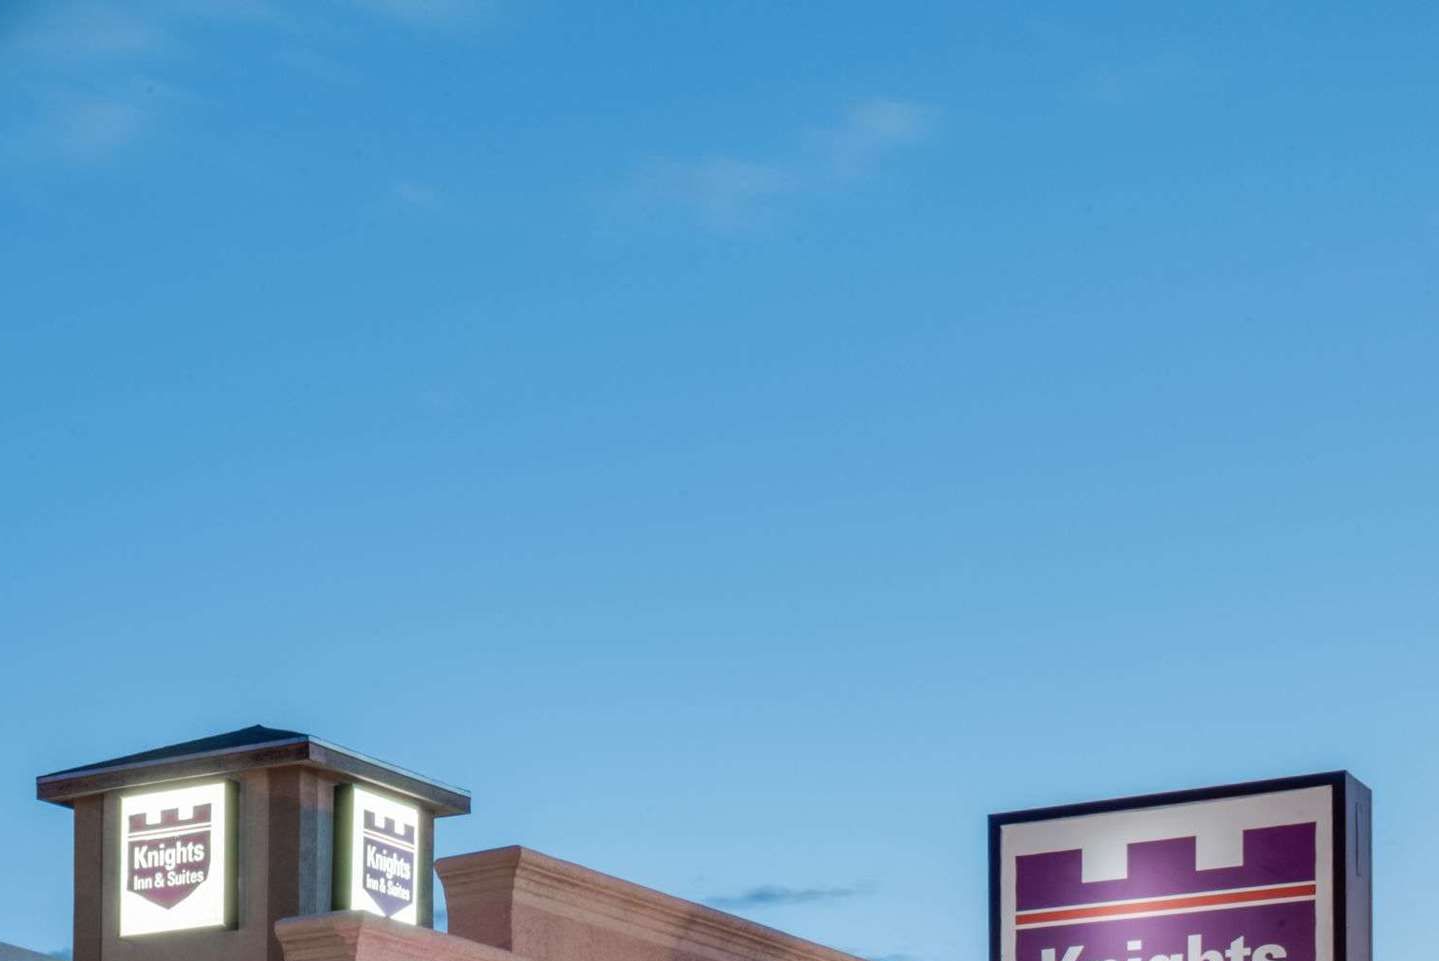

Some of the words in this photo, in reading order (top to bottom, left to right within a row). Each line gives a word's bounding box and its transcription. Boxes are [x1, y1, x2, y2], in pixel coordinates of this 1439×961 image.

[134, 841, 205, 871] Knights
[366, 844, 411, 880] Knights
[133, 875, 153, 891] Inn
[154, 872, 165, 888] &
[166, 869, 205, 887] Suites
[366, 873, 379, 891] Inn
[379, 877, 386, 894] &
[387, 879, 410, 901] Suites
